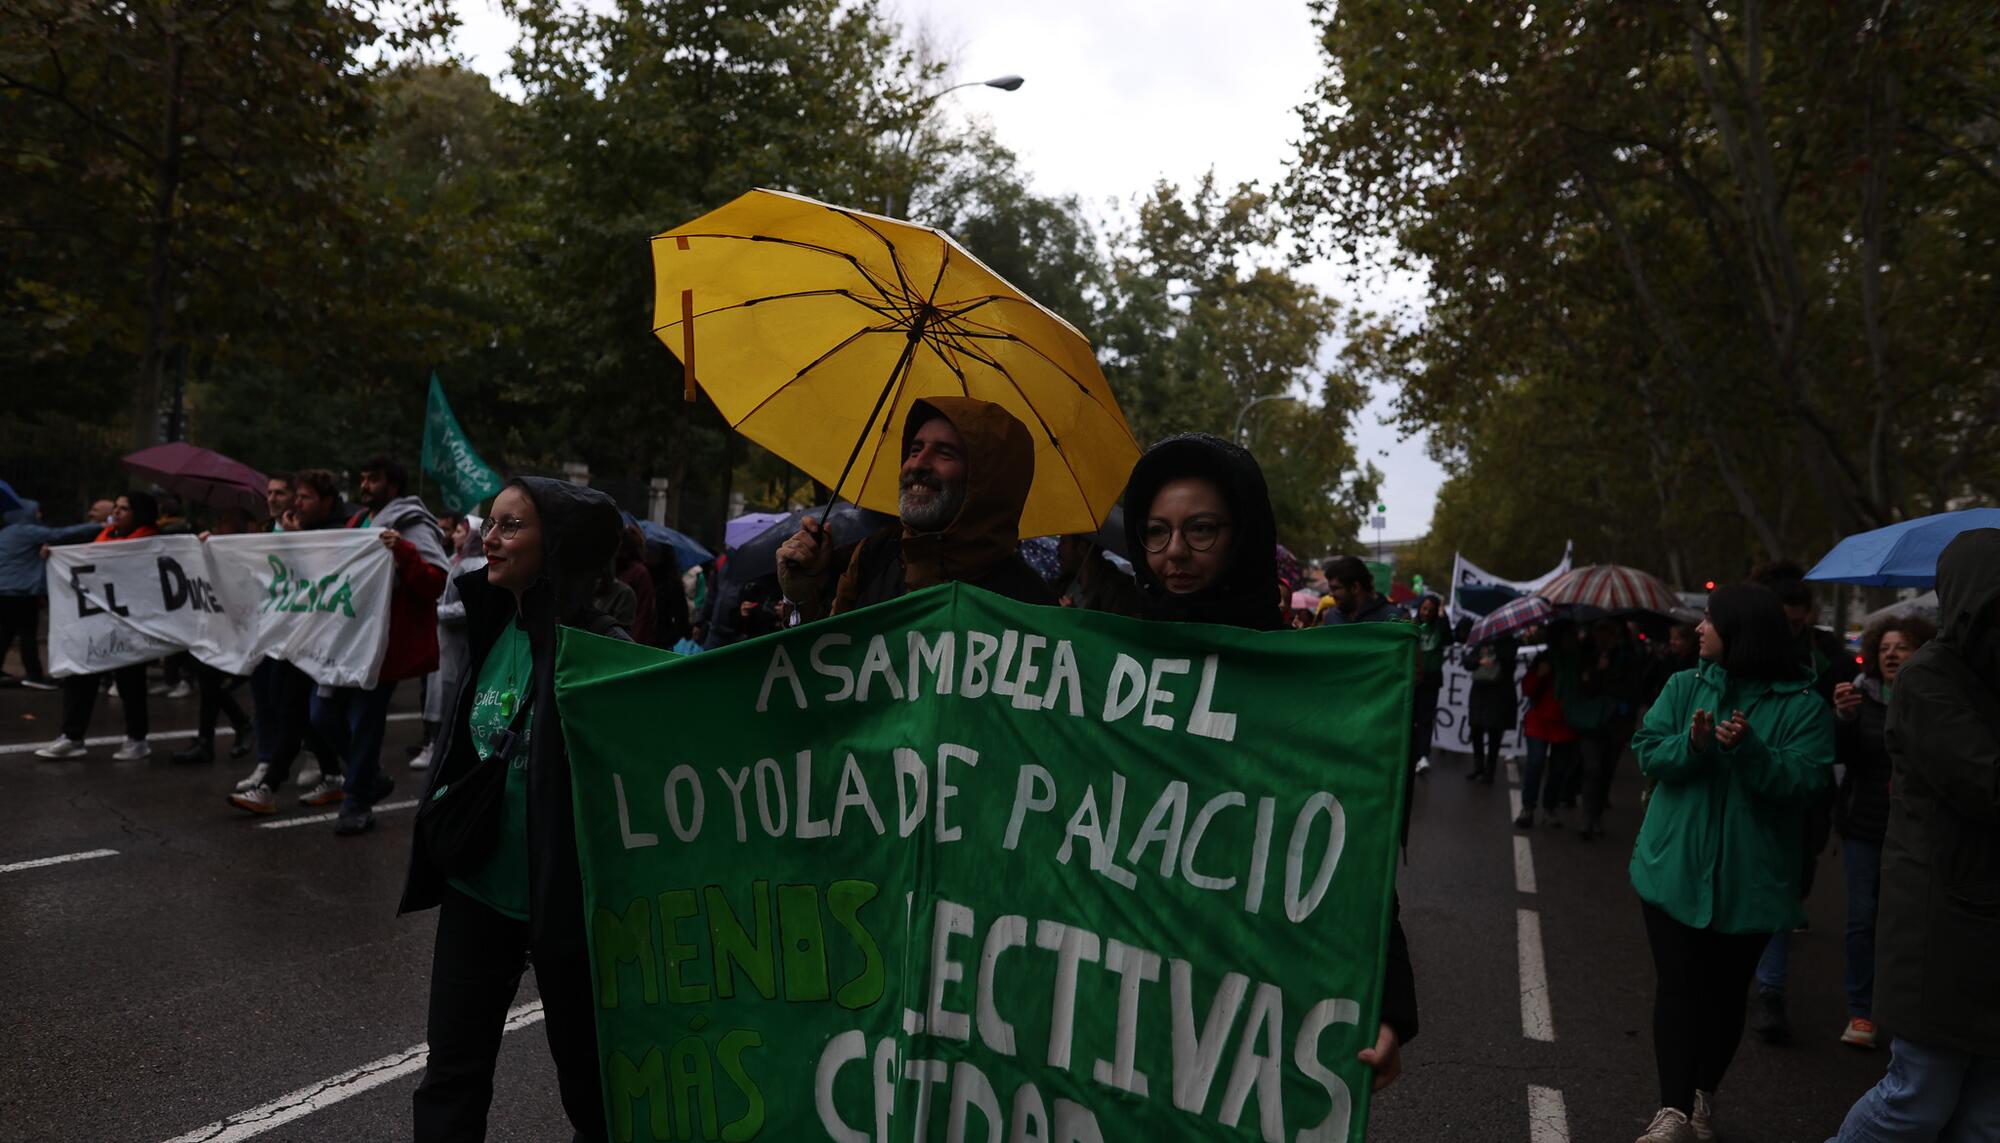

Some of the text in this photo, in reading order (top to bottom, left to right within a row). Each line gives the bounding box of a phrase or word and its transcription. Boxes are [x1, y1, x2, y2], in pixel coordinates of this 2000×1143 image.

[71, 565, 129, 617] EL
[756, 630, 1237, 742] ASAMBLEA DEL
[612, 743, 1346, 923] LOYOLA DE PALACIO
[591, 879, 886, 1011] MENOS
[606, 1013, 765, 1143] MÁS
